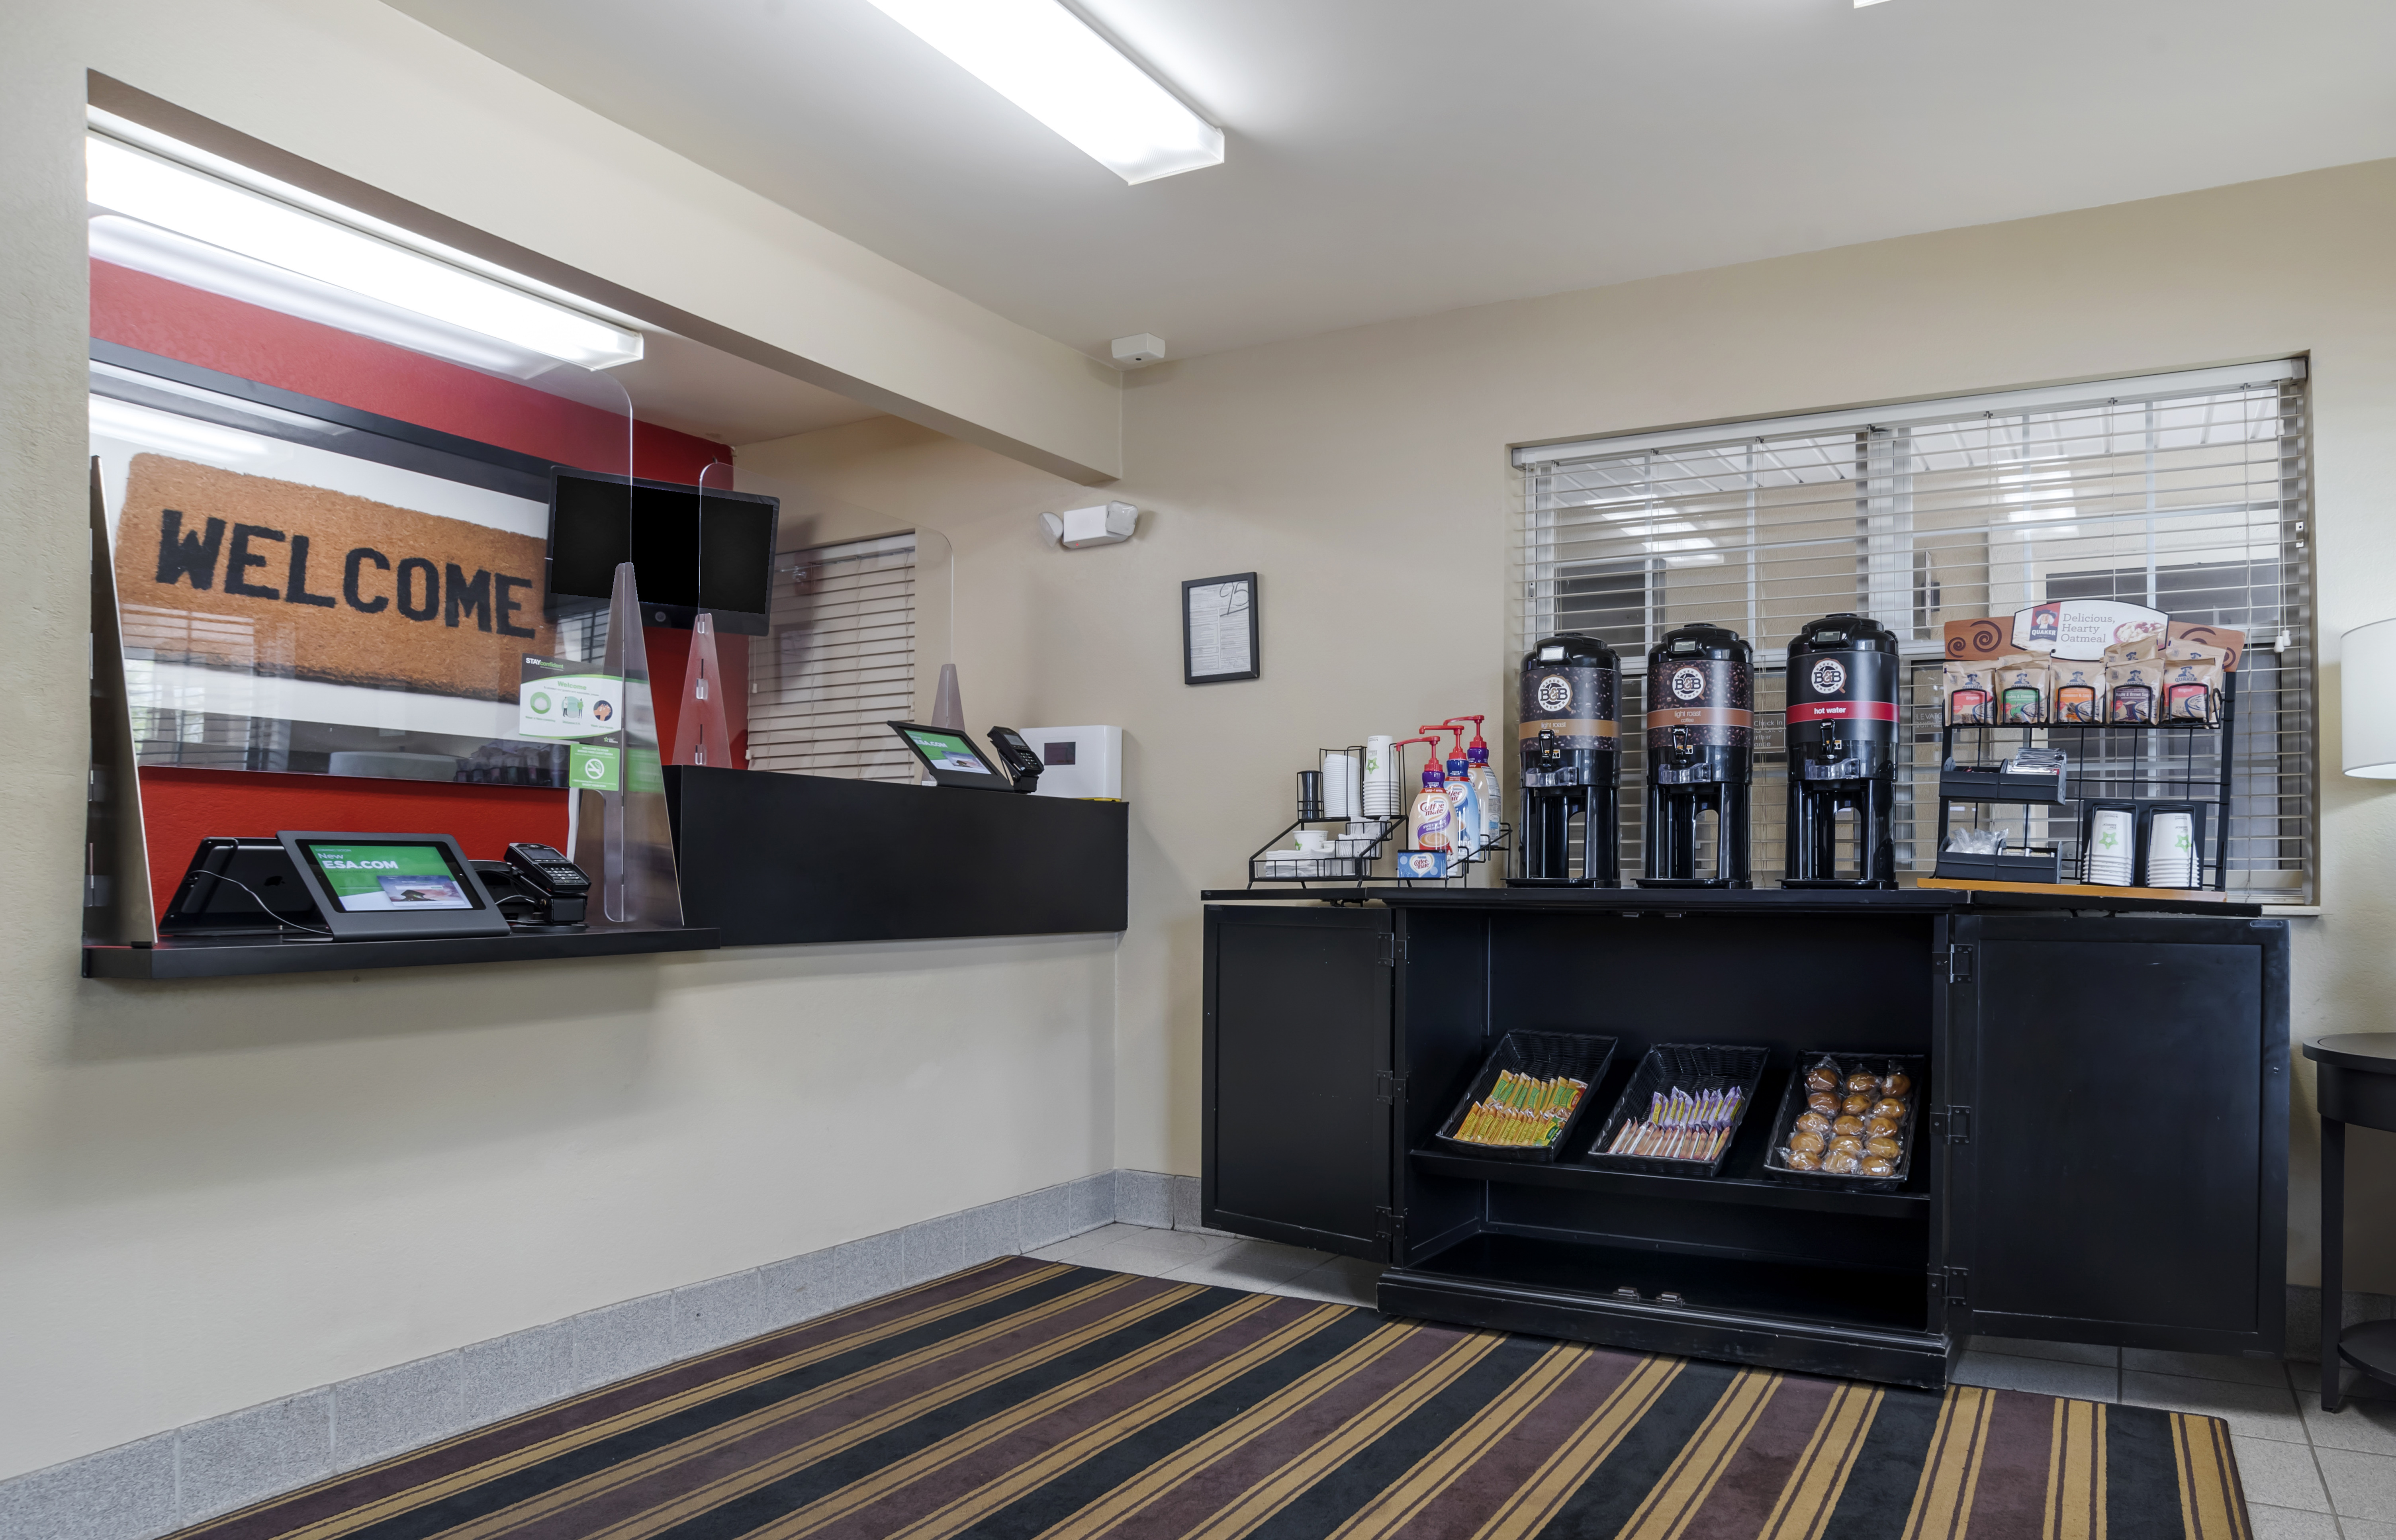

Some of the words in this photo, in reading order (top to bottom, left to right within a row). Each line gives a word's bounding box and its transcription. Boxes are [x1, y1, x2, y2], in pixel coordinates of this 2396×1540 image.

[155, 509, 535, 639] WELCOME
[2063, 613, 2115, 624] Delicious,
[2061, 624, 2100, 634] Hearty
[2061, 634, 2106, 643] Oatmeal
[1814, 671, 1842, 684] B&B
[558, 681, 587, 690] Welcome
[1675, 678, 1701, 690] B&B
[1540, 688, 1568, 701] B&B
[1420, 802, 1444, 812] Coffee
[322, 860, 399, 869] ESA.COM
